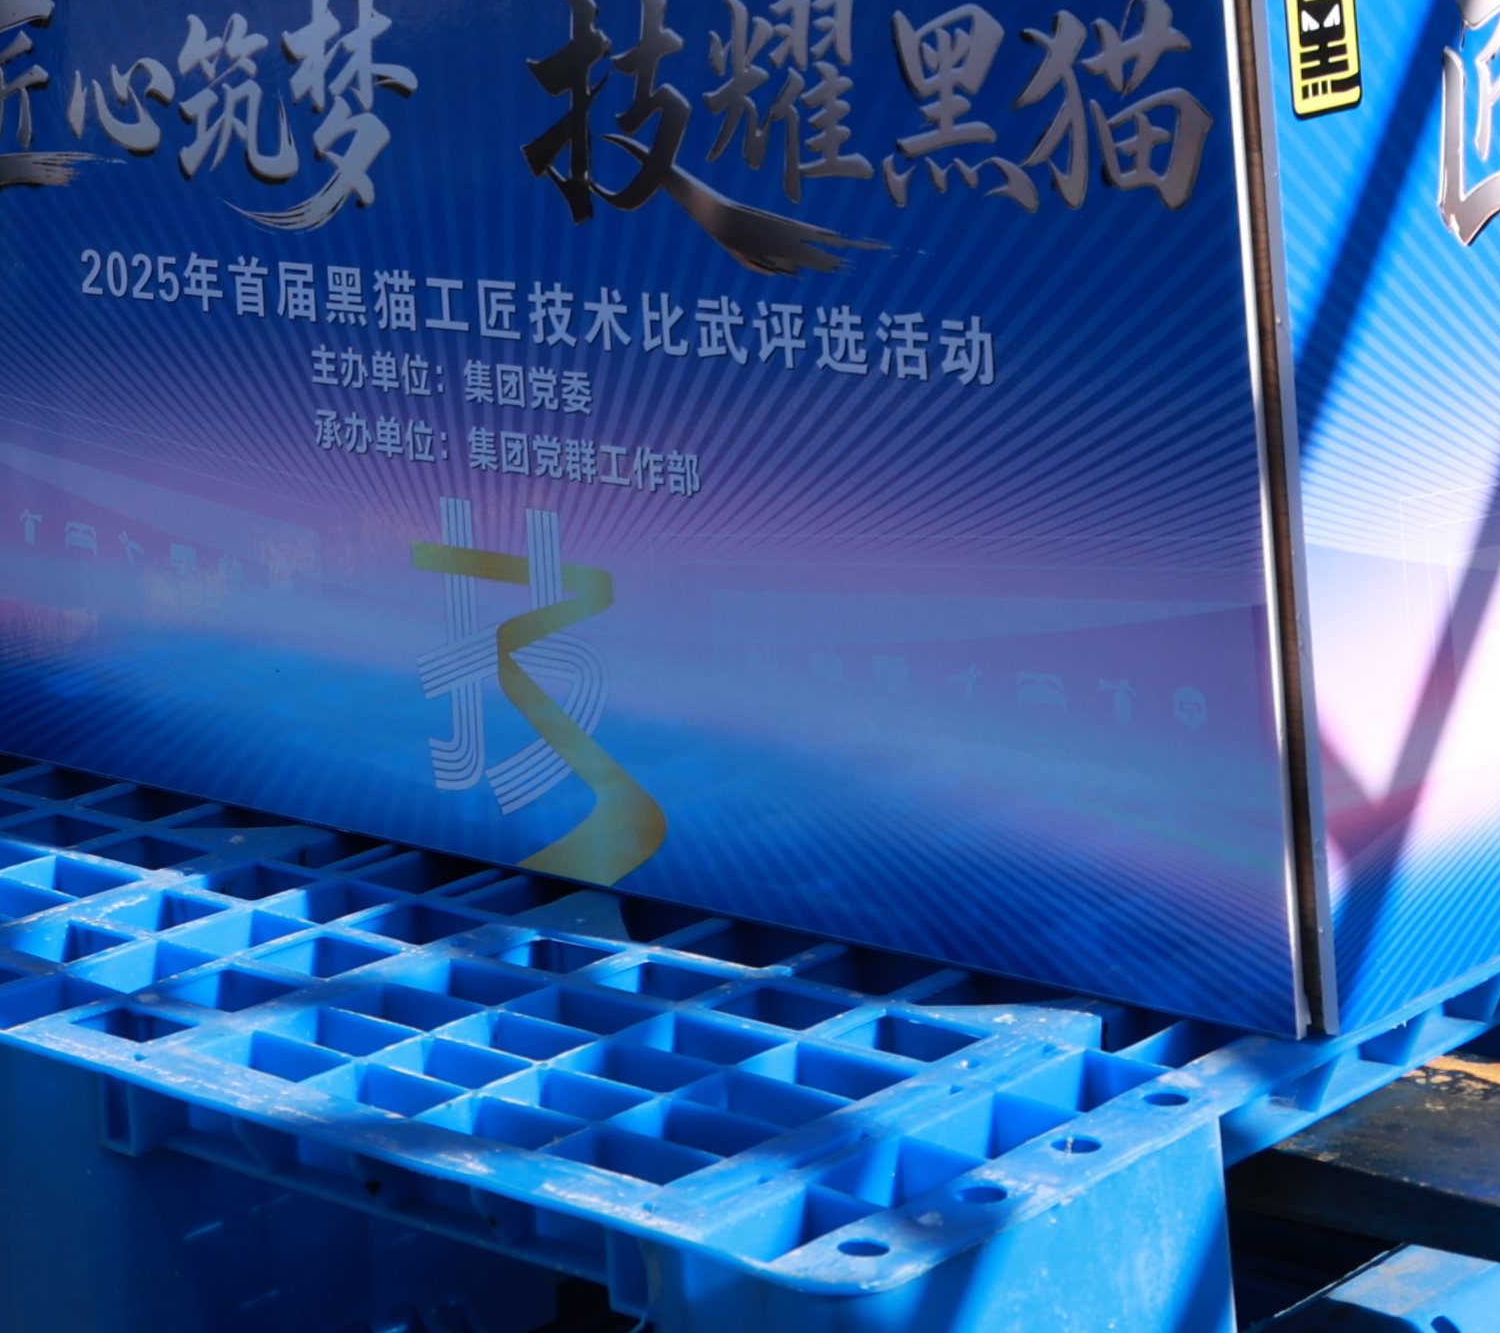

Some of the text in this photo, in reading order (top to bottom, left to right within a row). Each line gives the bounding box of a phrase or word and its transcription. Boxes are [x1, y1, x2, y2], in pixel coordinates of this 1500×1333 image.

[80, 247, 996, 387] 2025年首届黑猫工匠技术比武评选活动
